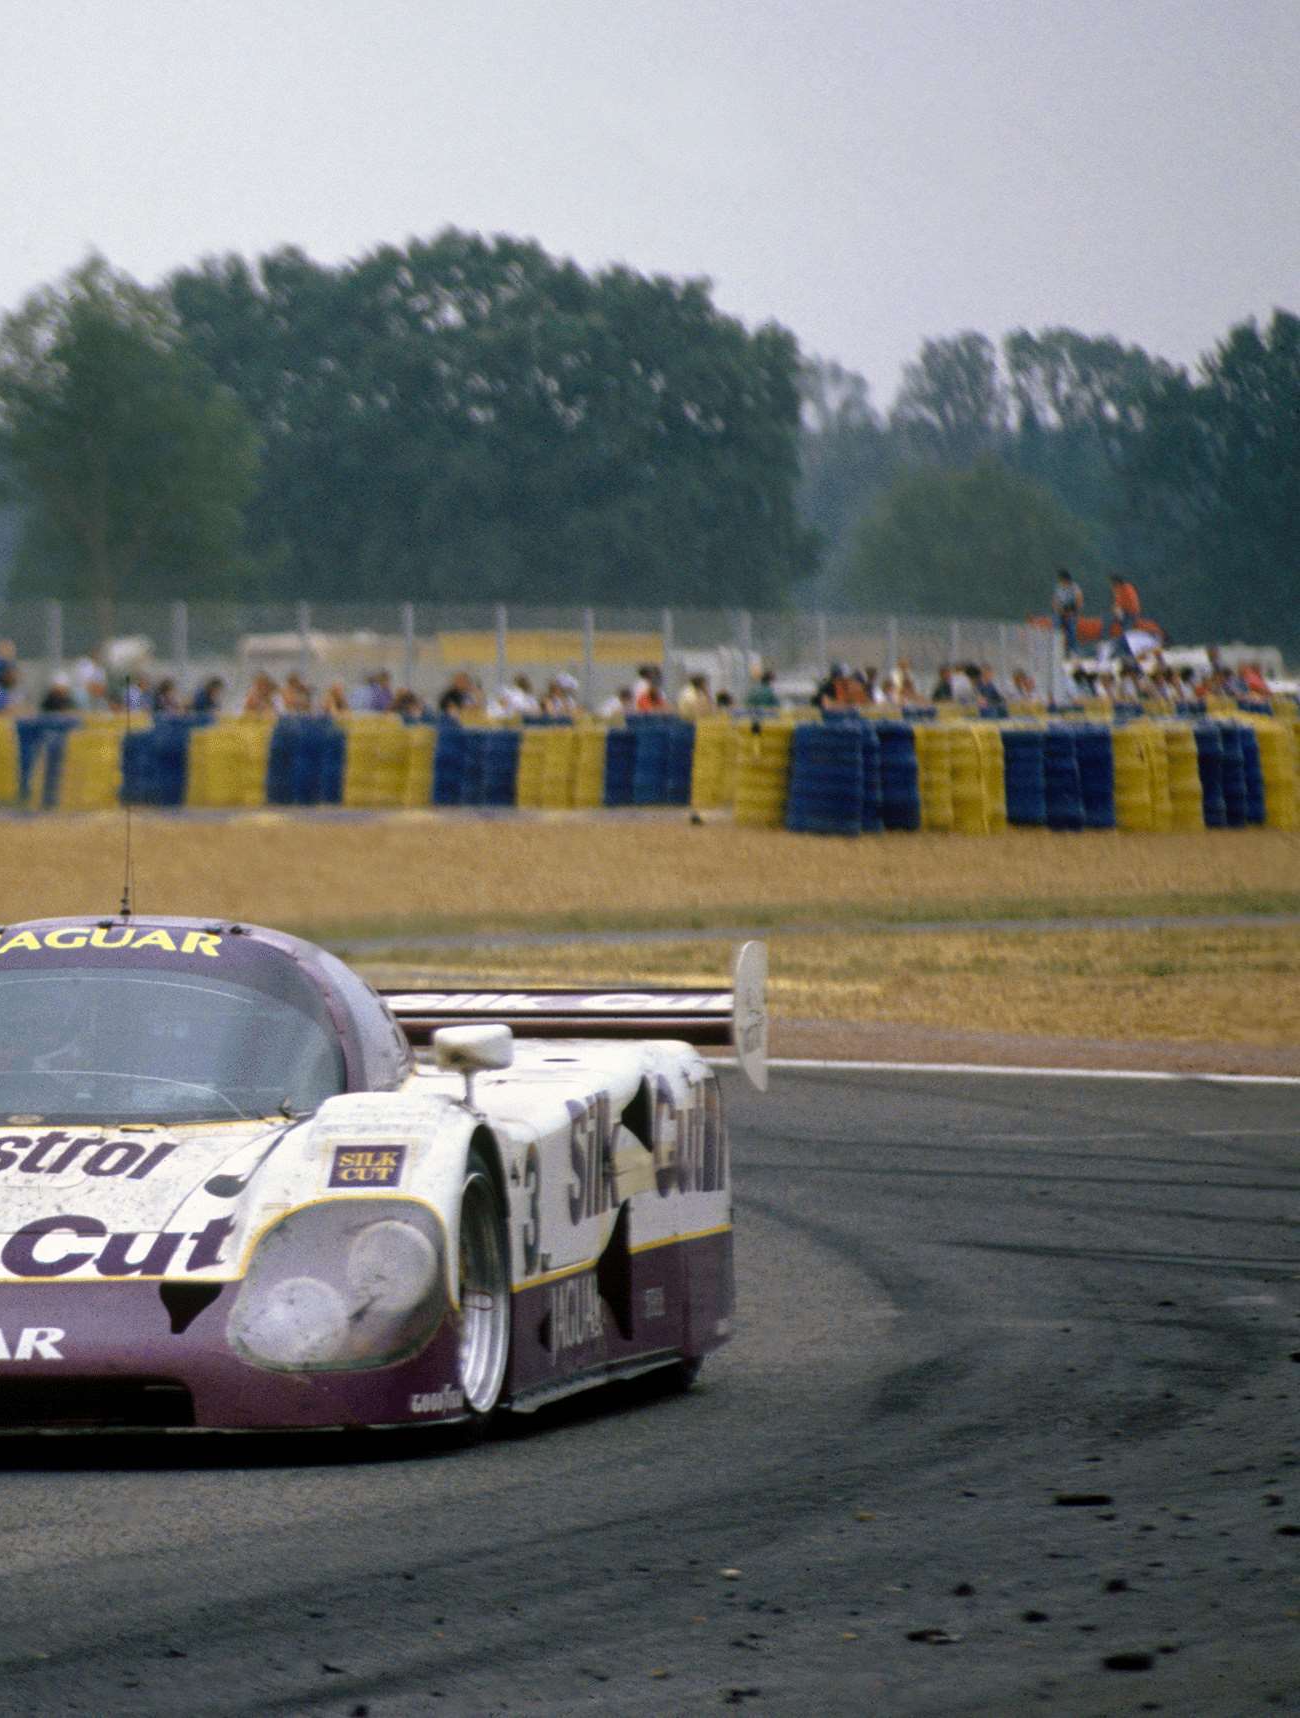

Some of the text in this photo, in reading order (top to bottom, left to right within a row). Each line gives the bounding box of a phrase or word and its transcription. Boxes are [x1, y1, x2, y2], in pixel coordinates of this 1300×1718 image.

[339, 1152, 399, 1167] SILK
[339, 1167, 394, 1181] CUT
[2, 1214, 236, 1278] Cut
